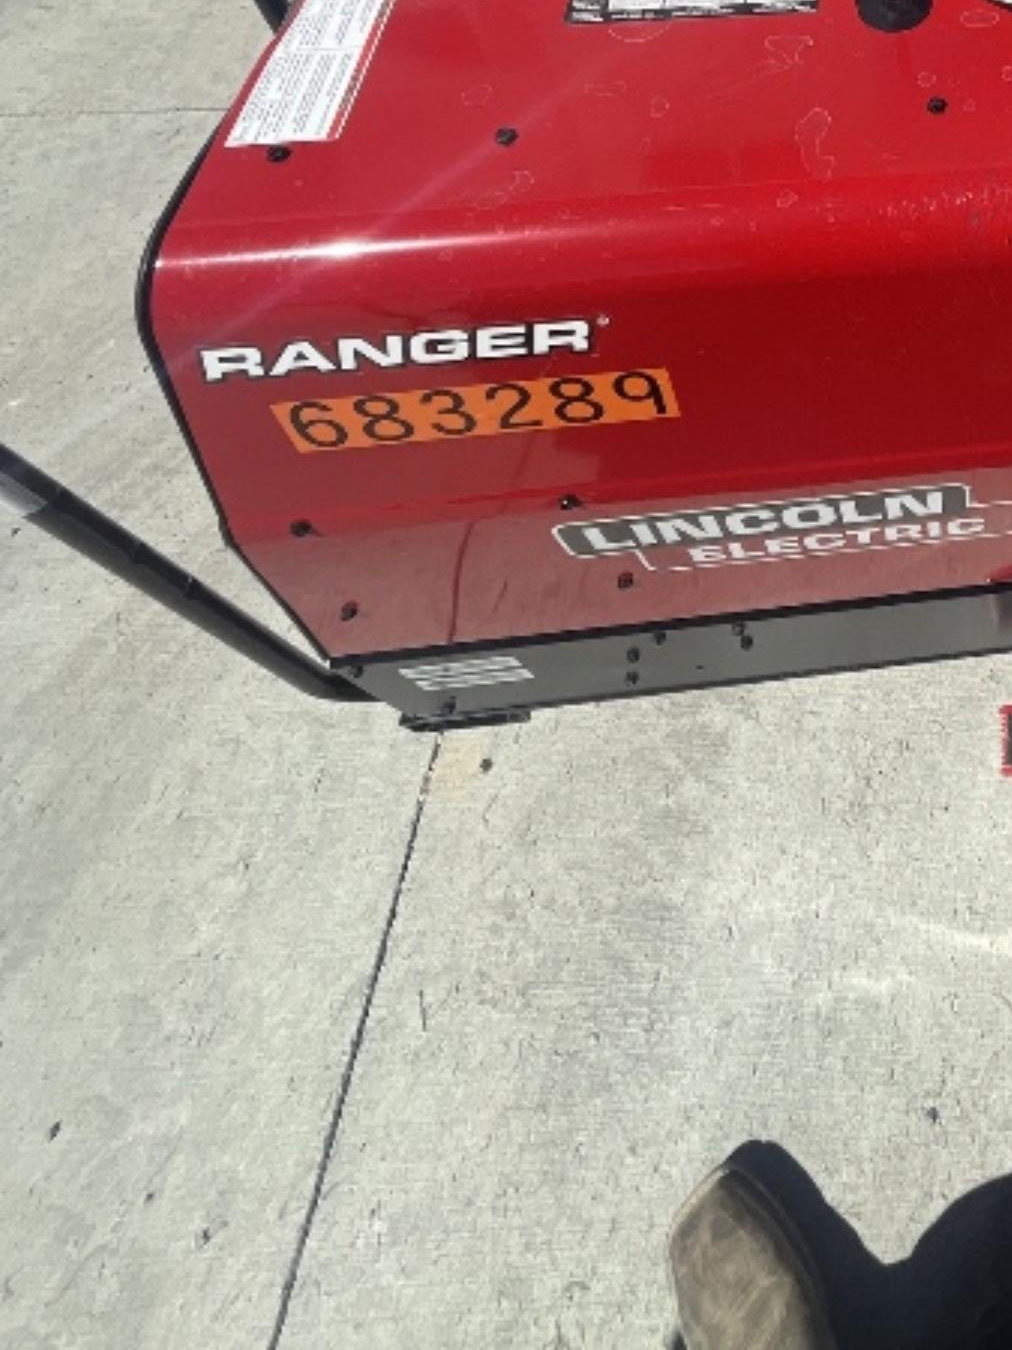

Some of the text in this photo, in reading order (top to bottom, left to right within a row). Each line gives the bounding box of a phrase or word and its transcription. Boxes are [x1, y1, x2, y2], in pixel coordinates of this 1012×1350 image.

[200, 319, 591, 383] RANGER
[289, 369, 667, 449] 683289
[580, 490, 945, 550] LINCOLN
[687, 517, 986, 564] ELECTRIC
